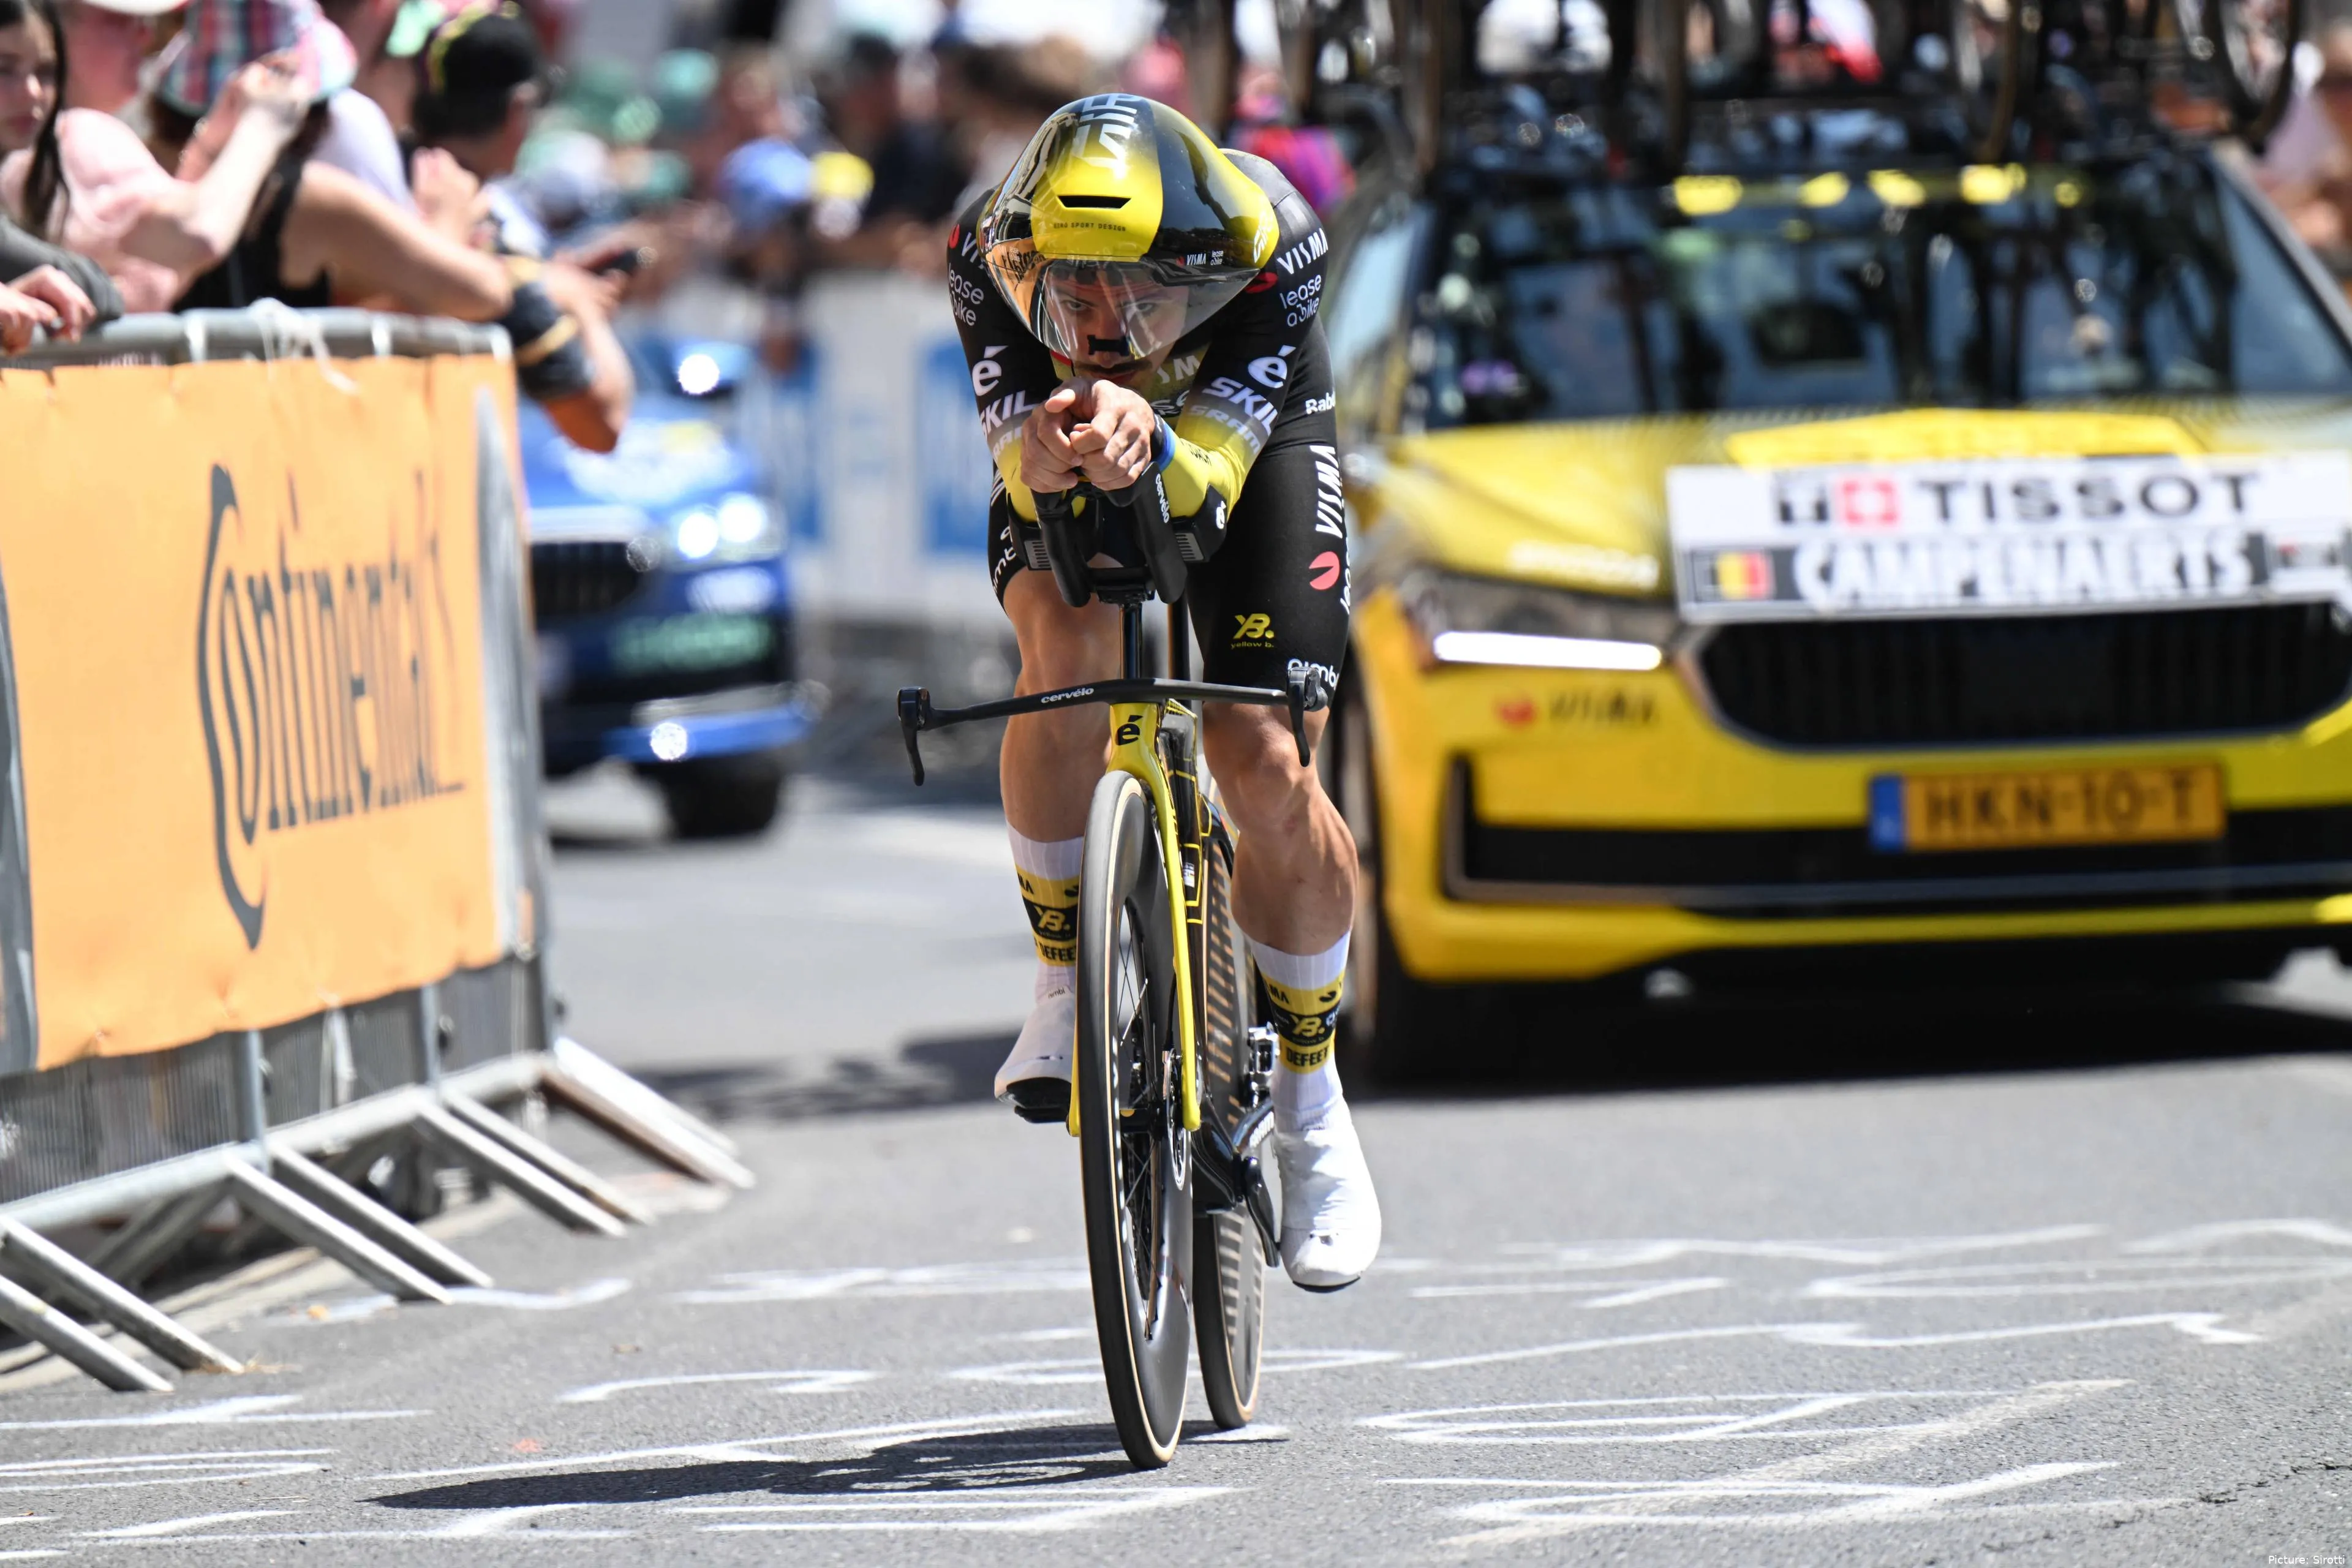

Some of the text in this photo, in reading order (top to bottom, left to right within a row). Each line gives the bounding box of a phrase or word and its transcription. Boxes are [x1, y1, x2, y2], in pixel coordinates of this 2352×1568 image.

[1098, 223, 1126, 232] DESIGN
[1186, 253, 1206, 266] VISMA
[1211, 249, 1224, 258] lease
[1276, 227, 1329, 274] VISMA
[1280, 274, 1322, 309] lease
[971, 345, 1009, 396] é
[1247, 344, 1297, 389] é
[1201, 376, 1278, 437] SKIL
[1189, 404, 1262, 456] SRAM
[1155, 473, 1170, 524] cervélo
[1309, 445, 1344, 540] VISMA
[1915, 473, 2260, 526] TISSOT
[1231, 641, 1262, 650] yellow
[194, 461, 466, 951] Continental
[1041, 687, 1095, 704] cervélo
[1115, 714, 1144, 746] é
[1048, 987, 1066, 999] nimbl
[1287, 1045, 1329, 1066] DEFEET
